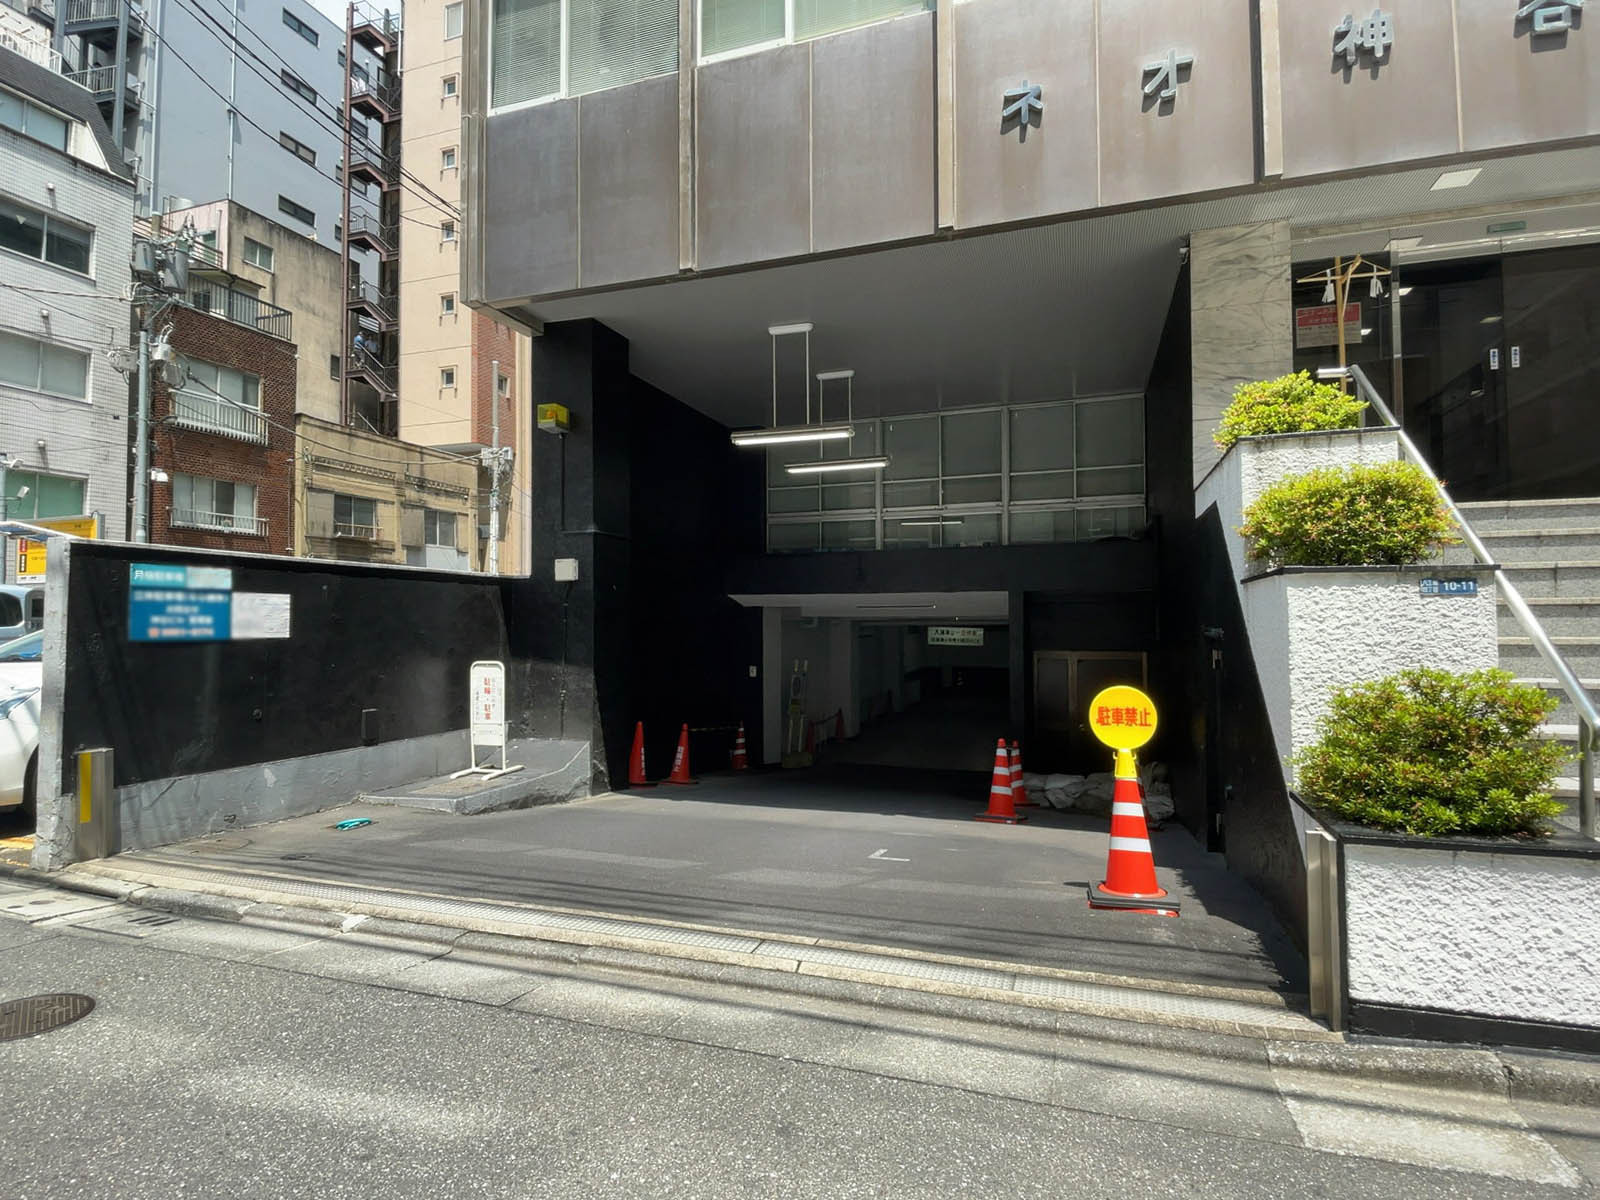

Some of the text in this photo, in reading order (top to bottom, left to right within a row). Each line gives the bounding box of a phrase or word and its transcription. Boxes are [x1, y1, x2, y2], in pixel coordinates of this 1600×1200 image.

[1443, 581, 1474, 591] 10-11
[1096, 706, 1152, 727] 駐車禁止
